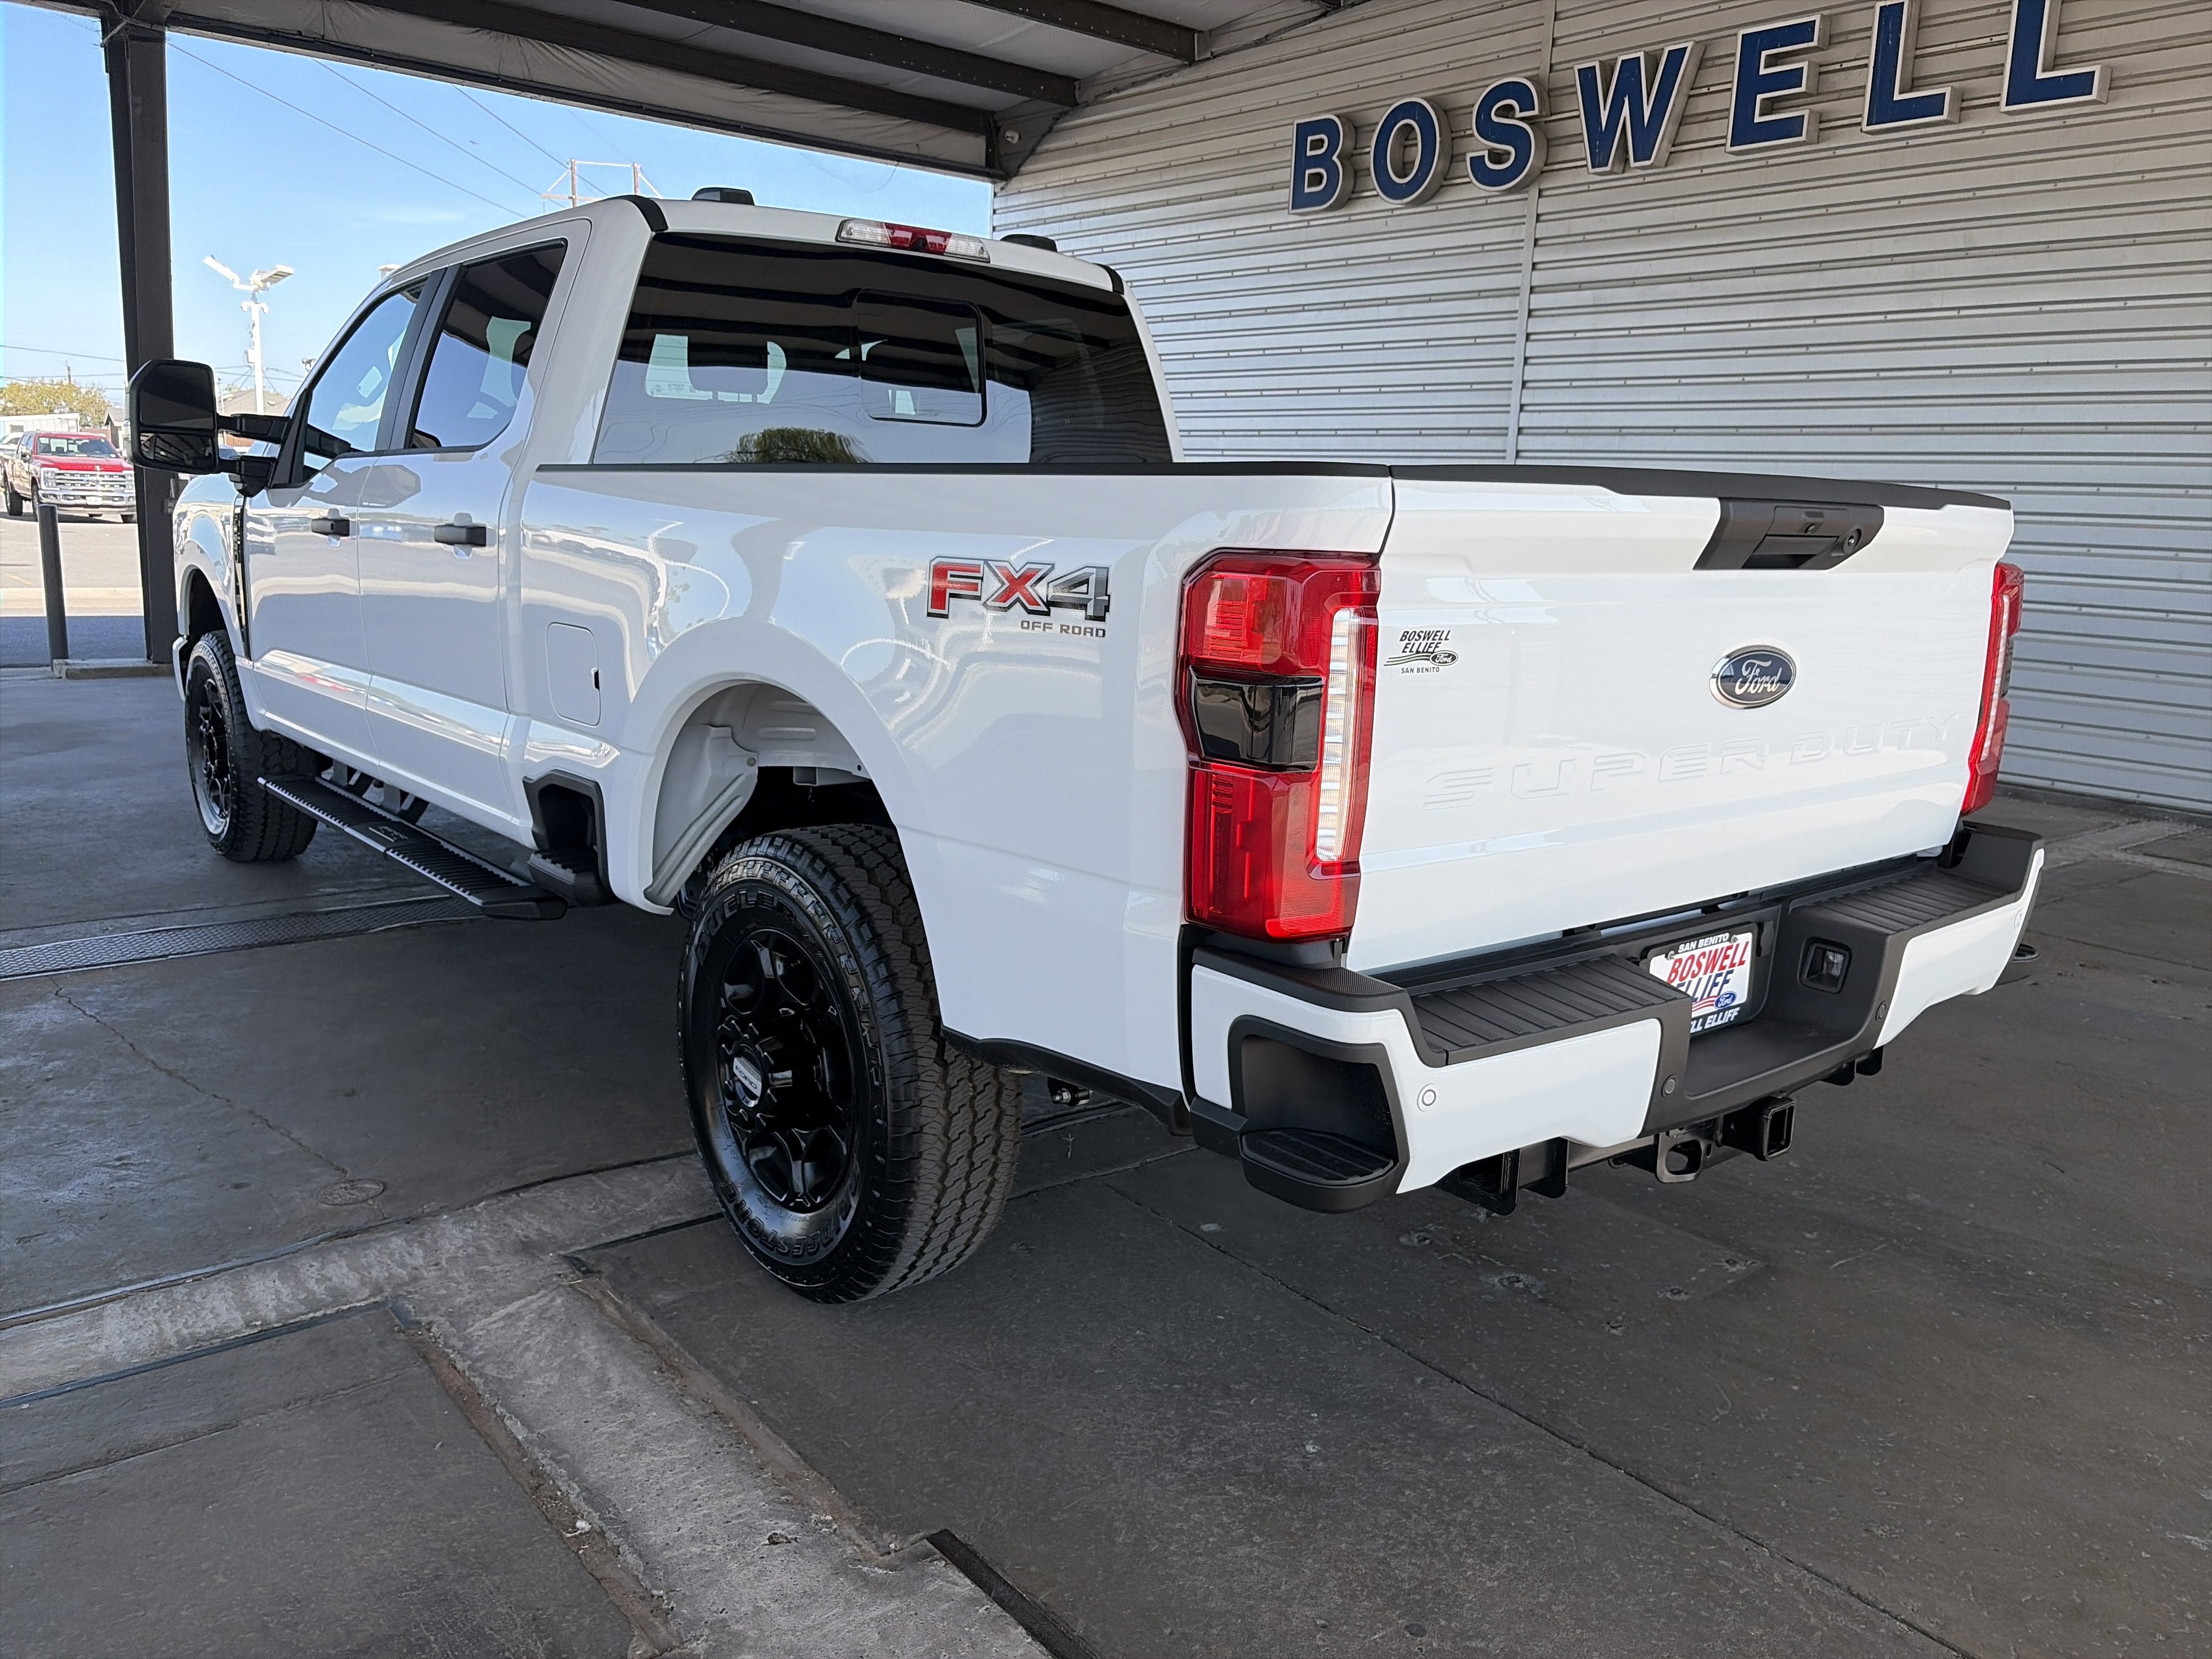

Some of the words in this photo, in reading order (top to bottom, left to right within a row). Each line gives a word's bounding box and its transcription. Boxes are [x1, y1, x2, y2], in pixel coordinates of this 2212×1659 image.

[1288, 0, 2111, 214] BOSWELL
[926, 555, 1111, 623] FX4
[1021, 620, 1053, 632] OFF
[1060, 624, 1106, 638] ROAD
[1400, 630, 1451, 641] BOSWELL
[1402, 641, 1442, 653] ELLIFF
[1435, 654, 1452, 663] Ford
[1735, 659, 1782, 695] Ford
[1423, 737, 1771, 811] SUPER
[1790, 714, 1960, 765] DUTY
[1678, 941, 1696, 953] SAN
[1697, 933, 1730, 948] BENITO
[1667, 941, 1750, 984] BOSWELL
[1718, 994, 1734, 1006] Ford
[1703, 1007, 1741, 1029] ELLIFF
[736, 1065, 757, 1090] FORD
